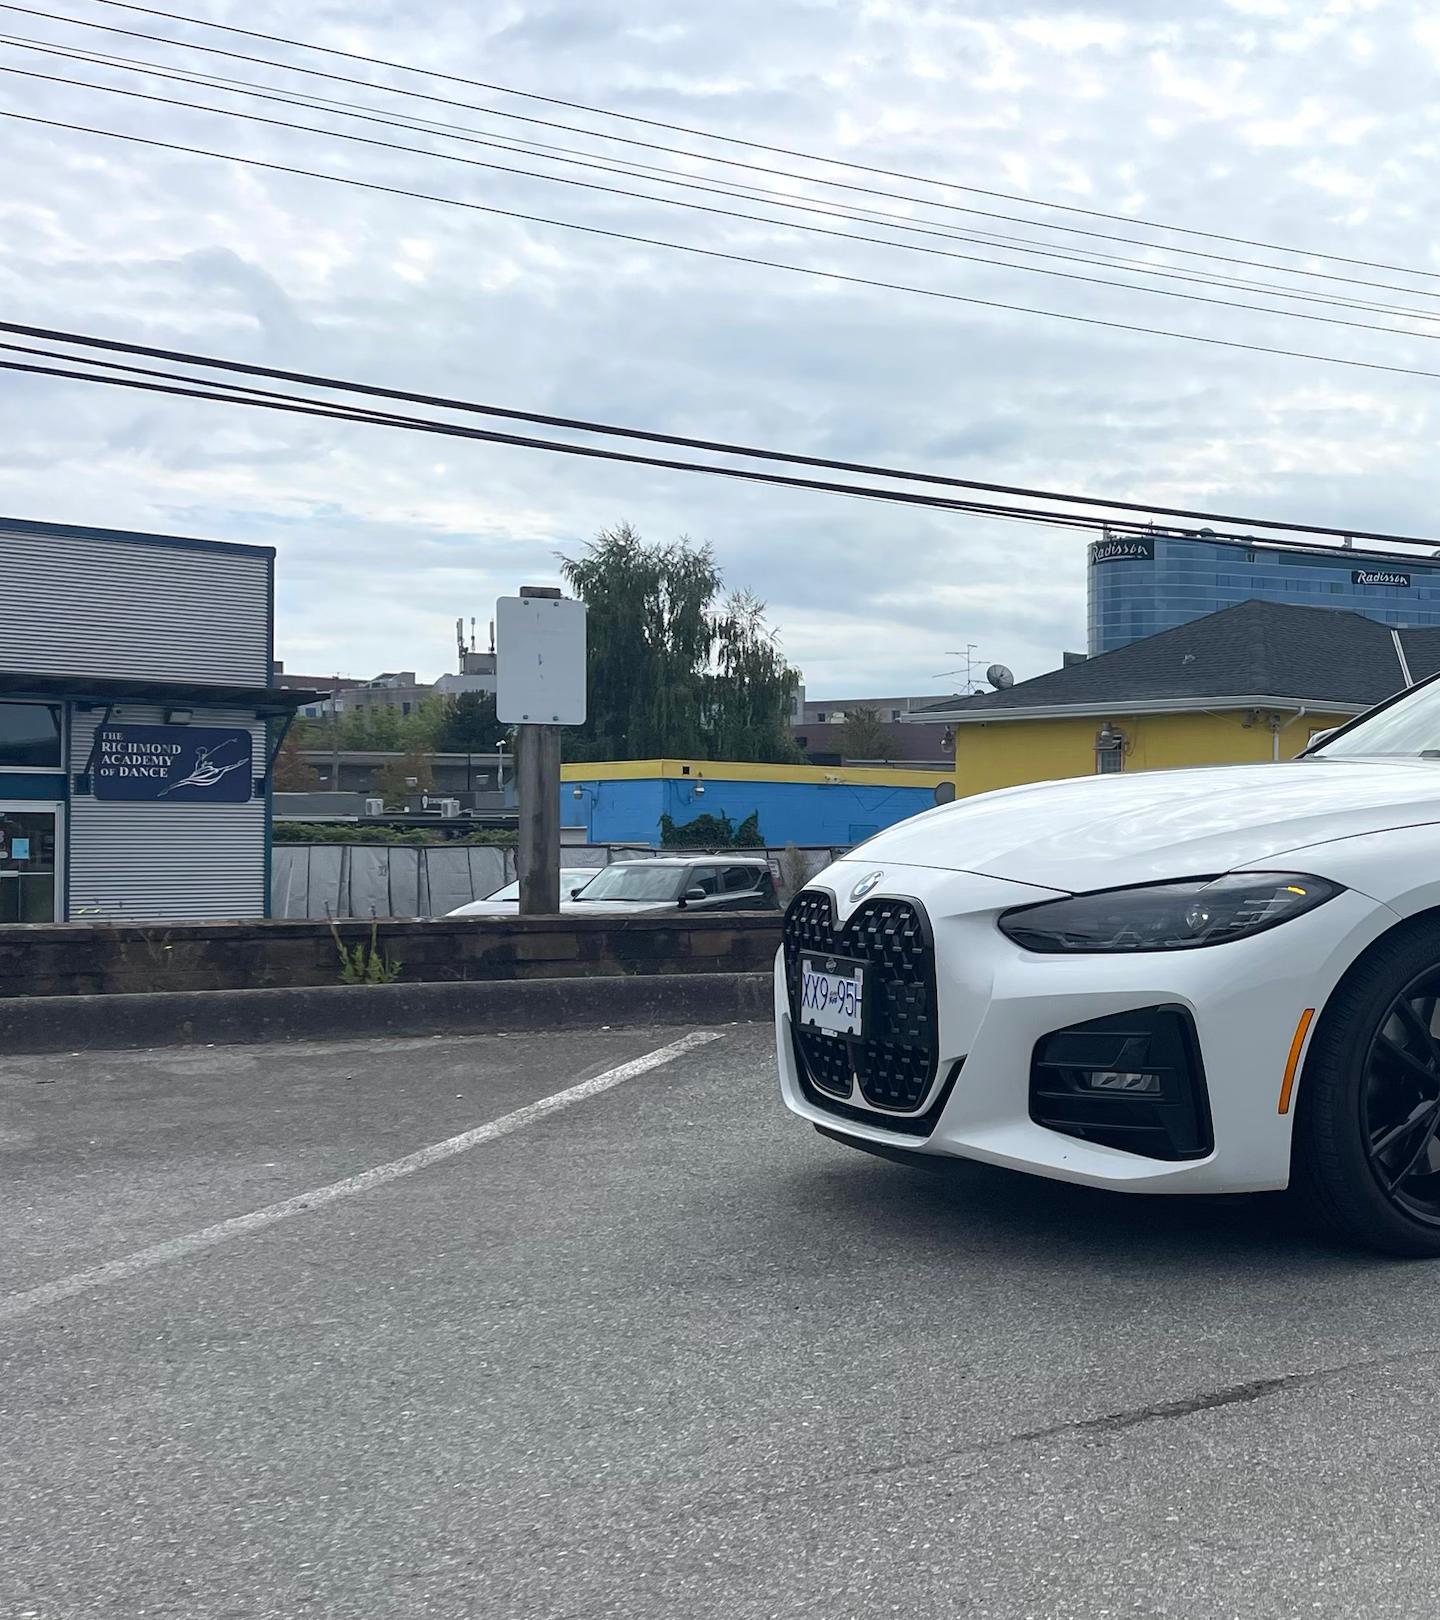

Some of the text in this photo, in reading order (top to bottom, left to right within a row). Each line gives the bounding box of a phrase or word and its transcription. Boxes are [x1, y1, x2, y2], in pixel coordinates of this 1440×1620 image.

[1092, 541, 1148, 562] Radisson
[1357, 570, 1408, 585] Radisson
[102, 732, 123, 741] THE
[101, 742, 181, 754] RICHMOND
[101, 755, 174, 766] ACADEMY
[100, 767, 168, 778] OF DANCE
